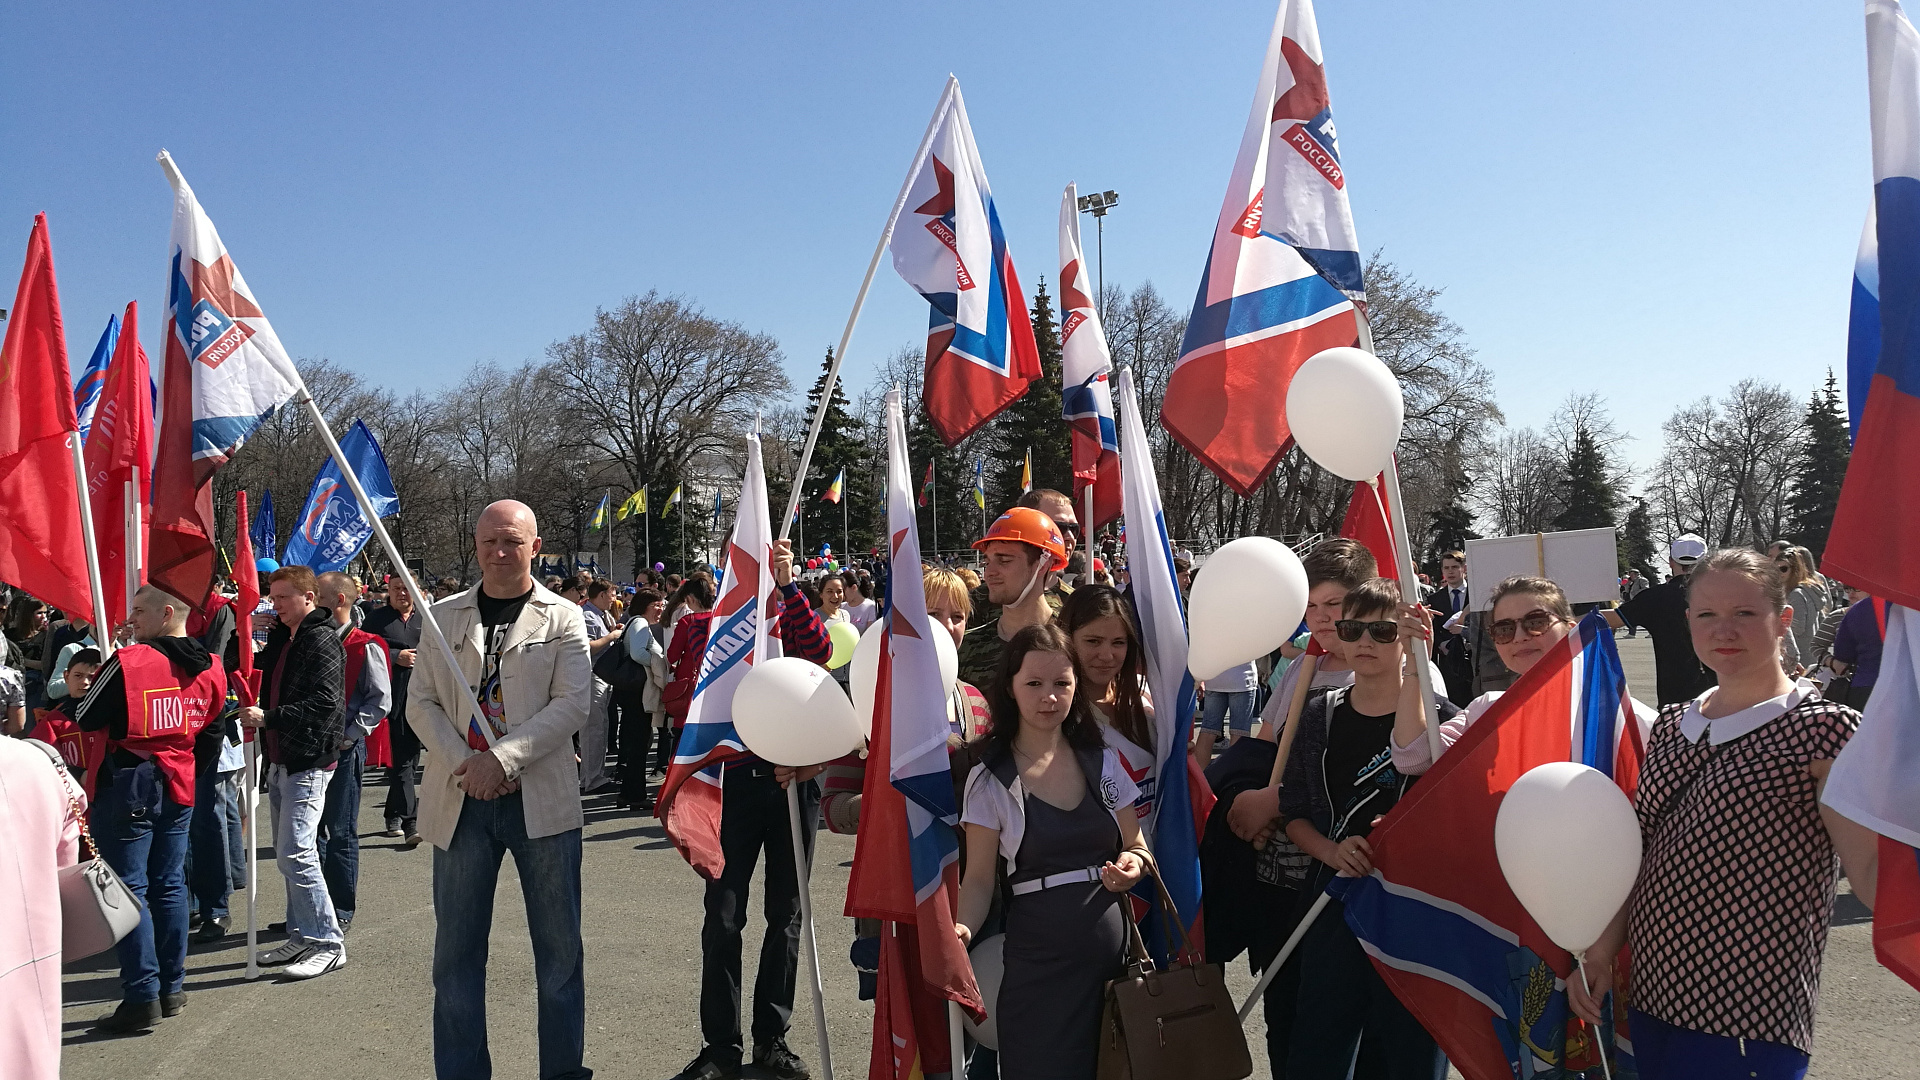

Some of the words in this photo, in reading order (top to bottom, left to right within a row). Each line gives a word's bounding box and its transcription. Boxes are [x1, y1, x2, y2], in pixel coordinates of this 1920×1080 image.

[1292, 133, 1341, 181] РОССИЯ
[932, 224, 957, 247] РОССИ
[956, 261, 970, 286] РТИЯ
[152, 696, 183, 731] ПВО
[1357, 746, 1392, 777] adid
